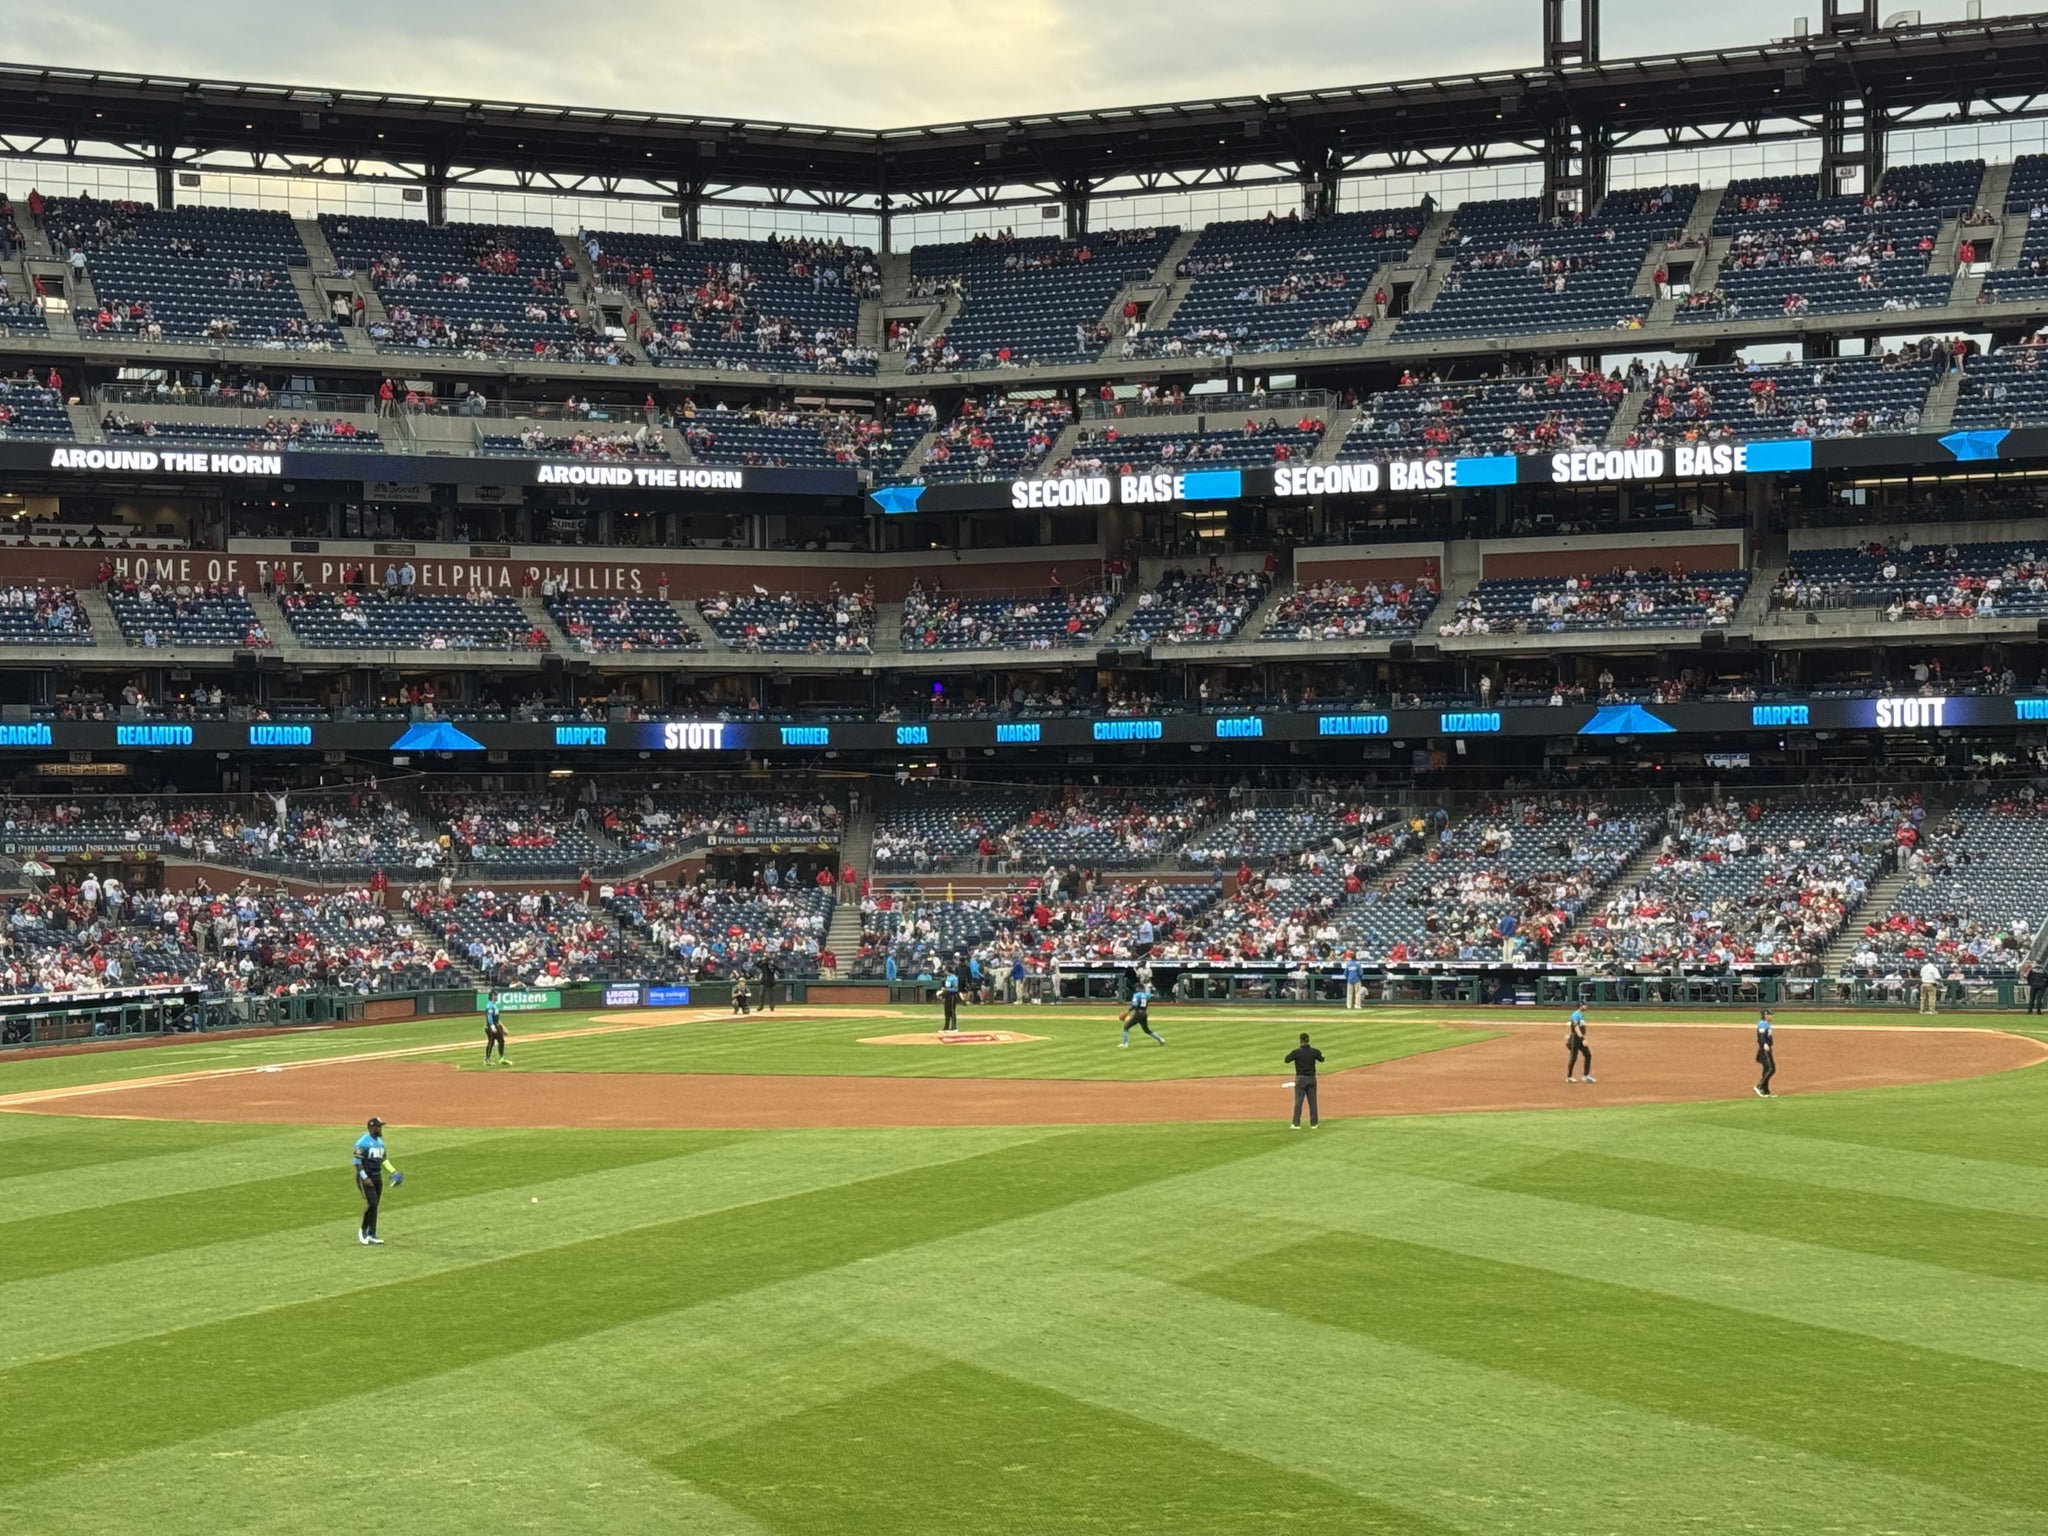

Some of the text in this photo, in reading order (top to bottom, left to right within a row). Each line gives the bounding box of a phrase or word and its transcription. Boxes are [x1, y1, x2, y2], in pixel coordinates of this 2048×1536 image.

[51, 449, 281, 475] AROUND THE HORN
[1551, 445, 1747, 482] SECOND BASE
[537, 465, 742, 488] AROUND THE HORN
[1274, 460, 1457, 496] SECOND BASE
[1011, 474, 1185, 509] SECOND BASE
[115, 557, 190, 584] HOME
[207, 559, 238, 583] OF
[1753, 705, 1809, 726] HARPER
[1876, 697, 1946, 728] STOTT
[2015, 699, 2048, 719] TUR
[1093, 720, 1163, 740] CRAWFORD
[1216, 716, 1263, 737] GARCÍA
[1319, 715, 1388, 735] REALMUTO
[1441, 712, 1501, 732] LUZARDO
[0, 722, 52, 745] GARCÍA
[117, 725, 193, 745] REALMUTO
[249, 726, 312, 745] LUZARDO
[555, 726, 607, 745] HARPER
[664, 723, 724, 750] STOTT
[780, 727, 829, 745] TURNER
[896, 726, 928, 745] SOSA
[996, 723, 1041, 743] MARSH
[17, 843, 83, 853] PHILADELPHIA
[85, 843, 136, 852] INSURANCE
[137, 843, 161, 852] CLUB
[718, 835, 773, 845] PHILADELPHIA
[502, 991, 548, 1004] Citizens
